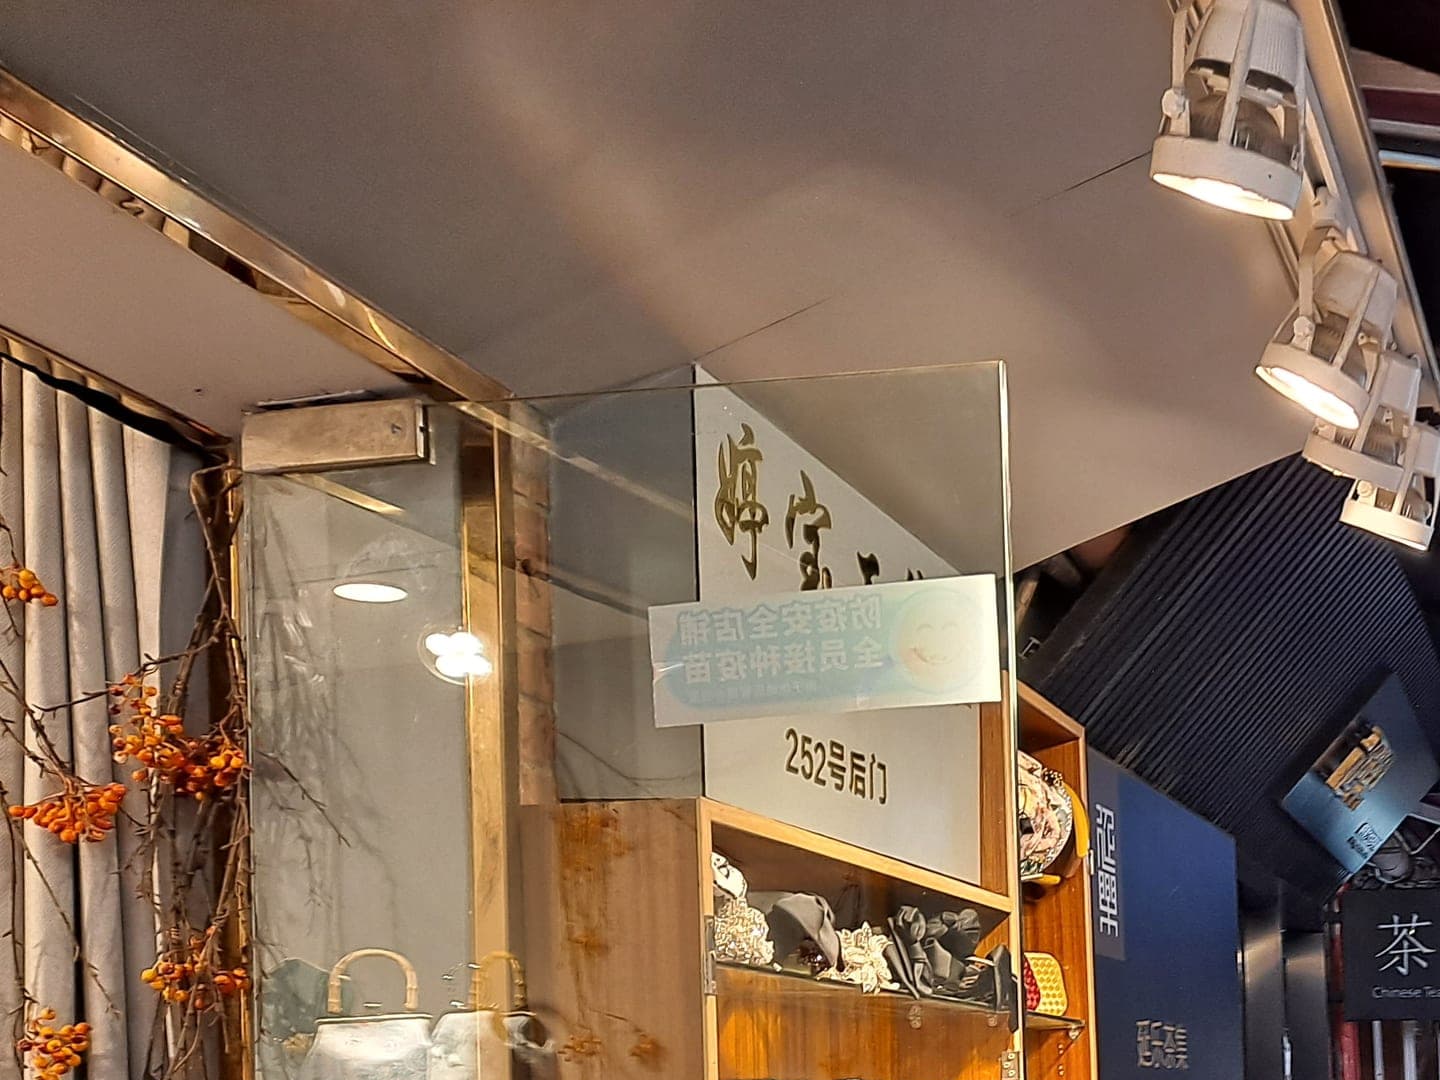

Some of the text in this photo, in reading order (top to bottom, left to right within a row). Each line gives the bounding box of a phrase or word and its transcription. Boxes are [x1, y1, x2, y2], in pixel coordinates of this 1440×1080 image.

[785, 728, 888, 805] 252号后门
[1375, 913, 1437, 976] 茶
[1372, 986, 1421, 999] Chinese
